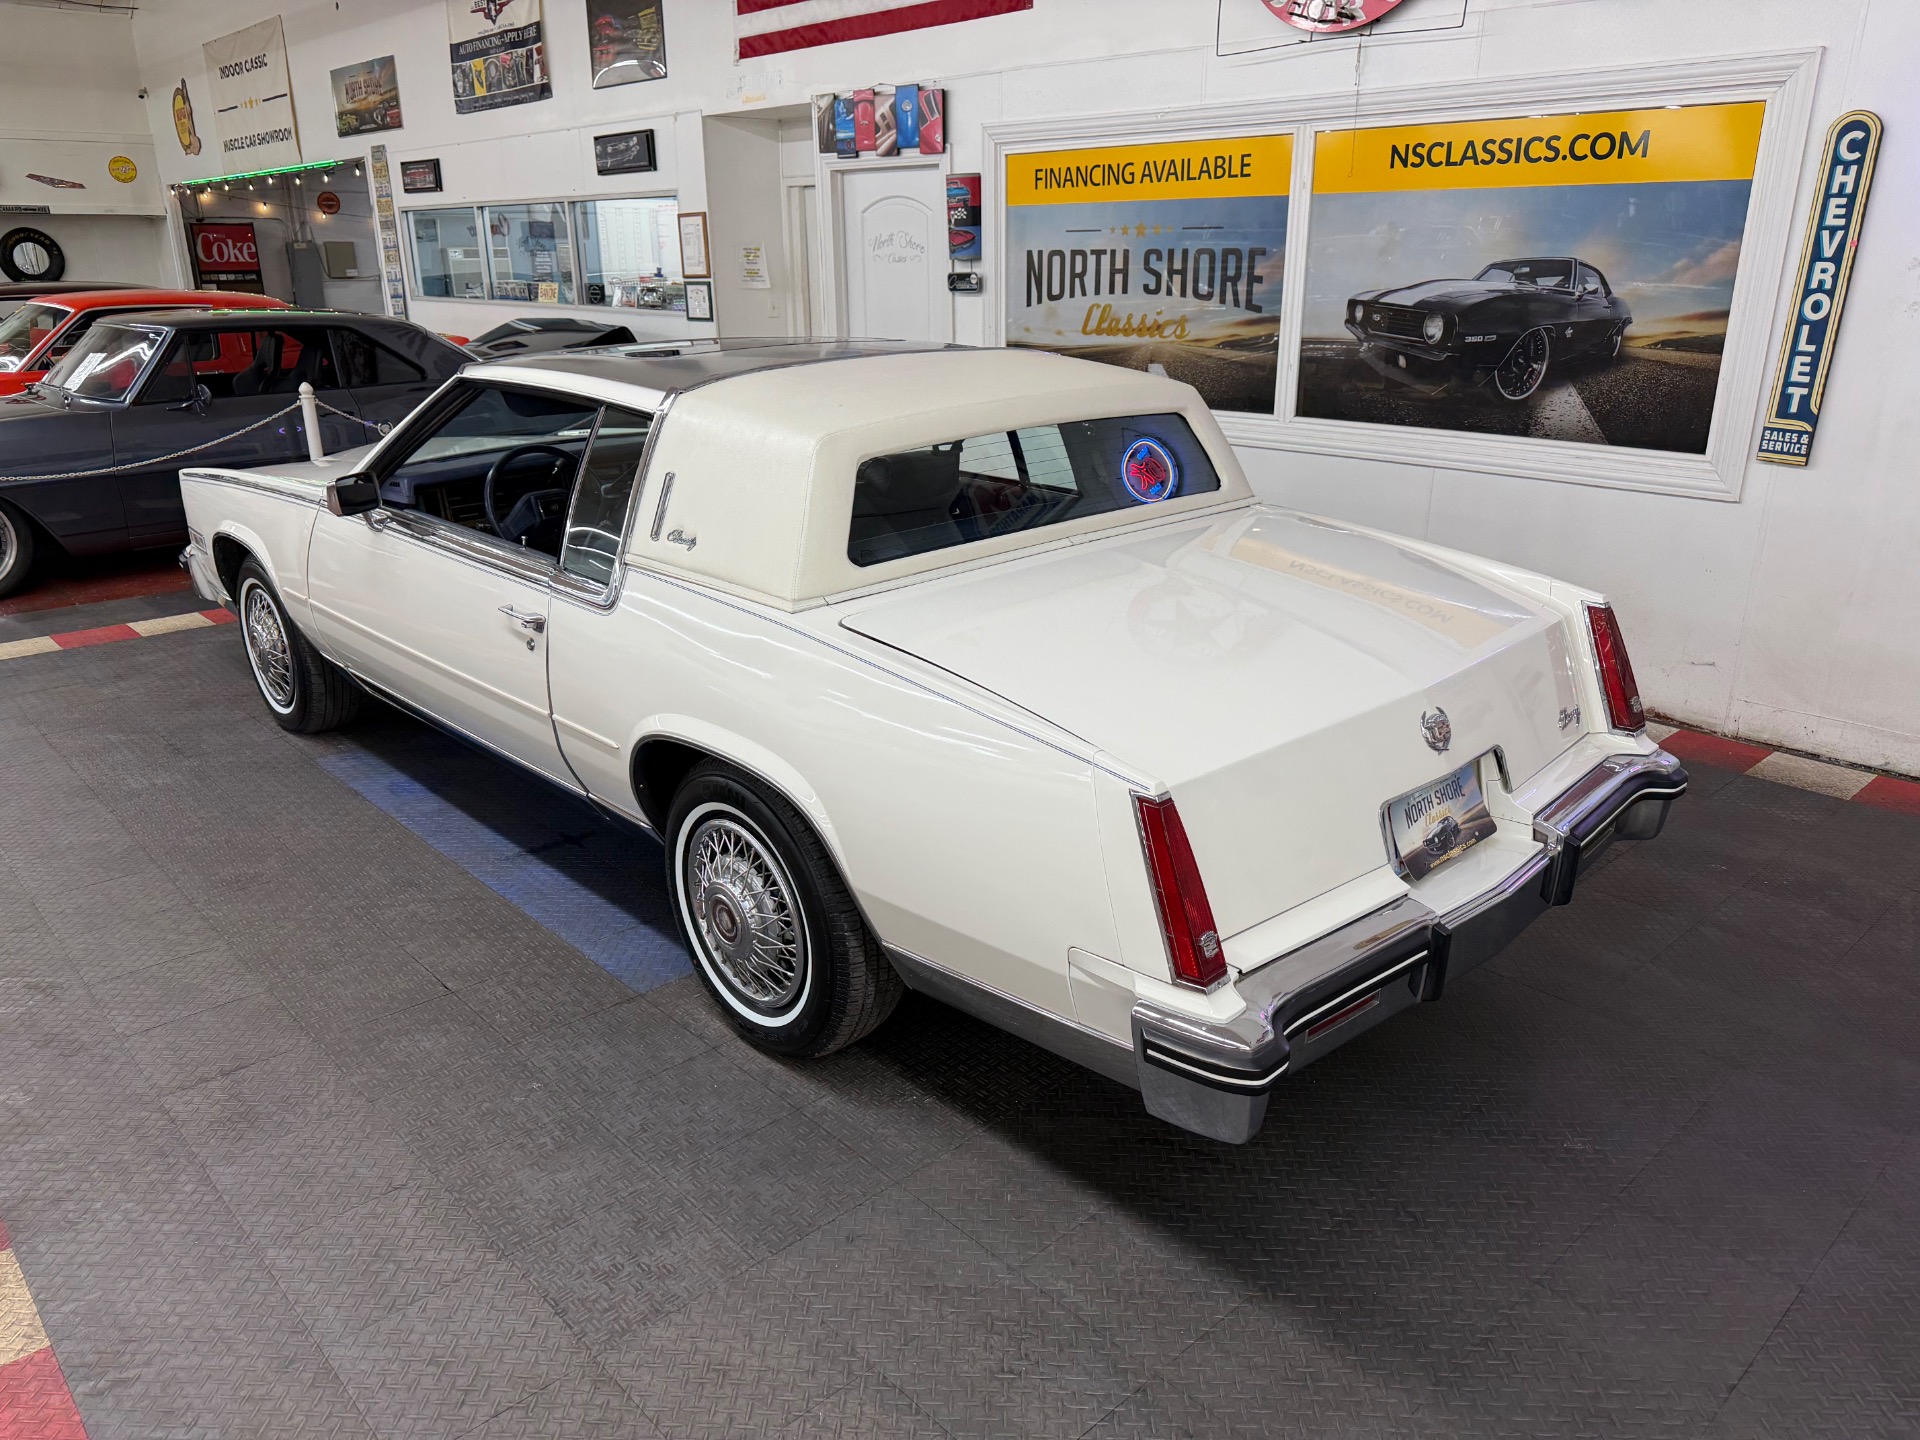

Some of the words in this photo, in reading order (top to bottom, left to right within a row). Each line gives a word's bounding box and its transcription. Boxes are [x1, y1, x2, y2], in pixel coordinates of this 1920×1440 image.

[459, 44, 474, 55] AUTO
[473, 35, 502, 51] FINANCING
[504, 29, 524, 43] APPLY
[522, 25, 538, 39] HERE
[219, 62, 244, 79] INDOOR
[244, 53, 268, 73] CLASSIC
[223, 136, 245, 153] MUSCLE
[245, 134, 257, 149] CAR
[257, 127, 293, 146] SHOWROOM
[1390, 130, 1651, 169] NSCLASSICS.COM
[1034, 162, 1135, 190] FINANCING
[1139, 153, 1252, 184] AVAILABLE
[196, 233, 258, 263] Coke
[868, 231, 895, 252] North
[896, 230, 925, 254] Shore
[1026, 248, 1130, 307] NORTH
[1142, 247, 1267, 313] SHORE
[1785, 130, 1866, 414] CHEVROLET
[1081, 303, 1191, 340] Classics
[1761, 440, 1808, 455] SERVICE
[1764, 430, 1799, 443] SALES
[1800, 434, 1810, 444] &
[1404, 794, 1435, 829] NORTH
[1434, 777, 1466, 805] SHORE
[1430, 838, 1477, 869] www.nsclassics.com
